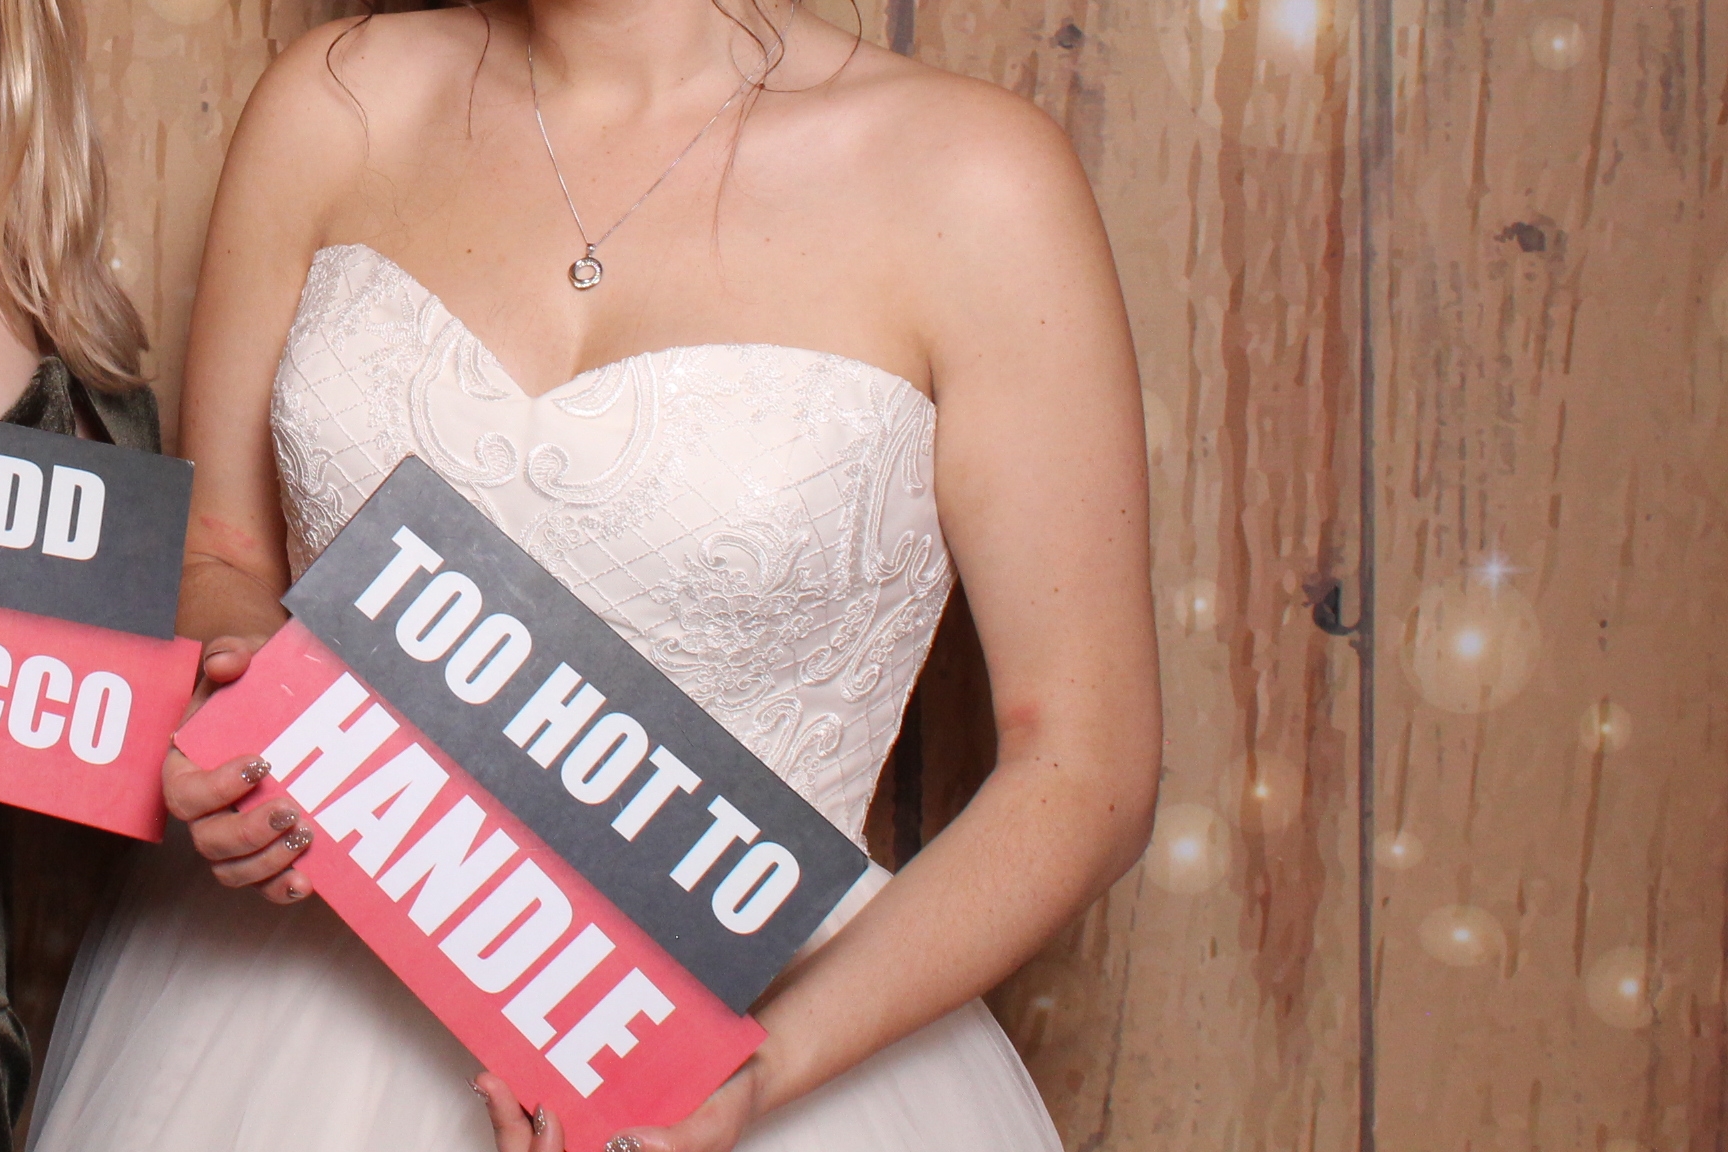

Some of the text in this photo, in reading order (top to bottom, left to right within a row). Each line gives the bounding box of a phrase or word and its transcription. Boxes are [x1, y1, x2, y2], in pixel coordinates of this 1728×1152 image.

[259, 671, 676, 1099] HANDLE
[353, 525, 801, 934] TOO HOT TO
